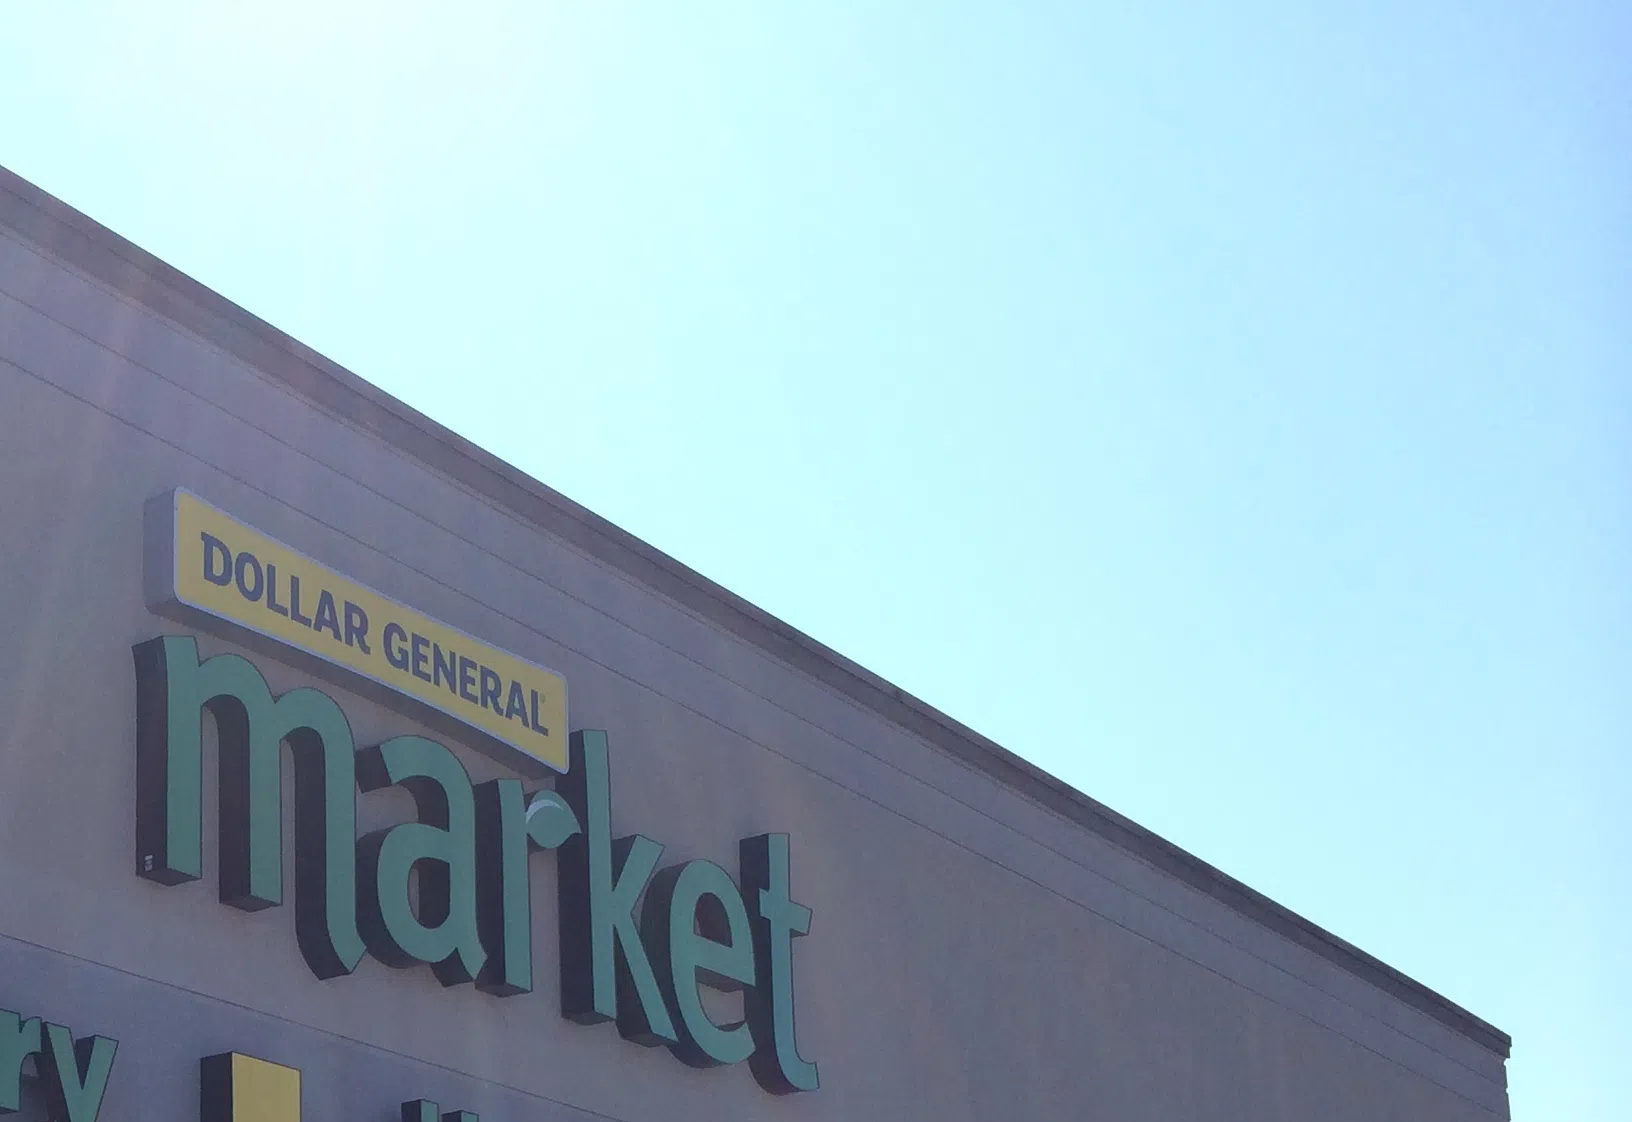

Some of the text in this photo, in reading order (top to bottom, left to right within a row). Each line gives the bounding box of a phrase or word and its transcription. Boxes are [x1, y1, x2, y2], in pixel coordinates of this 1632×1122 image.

[201, 532, 549, 737] DOLLAR GENERAL
[156, 635, 820, 1093] market
